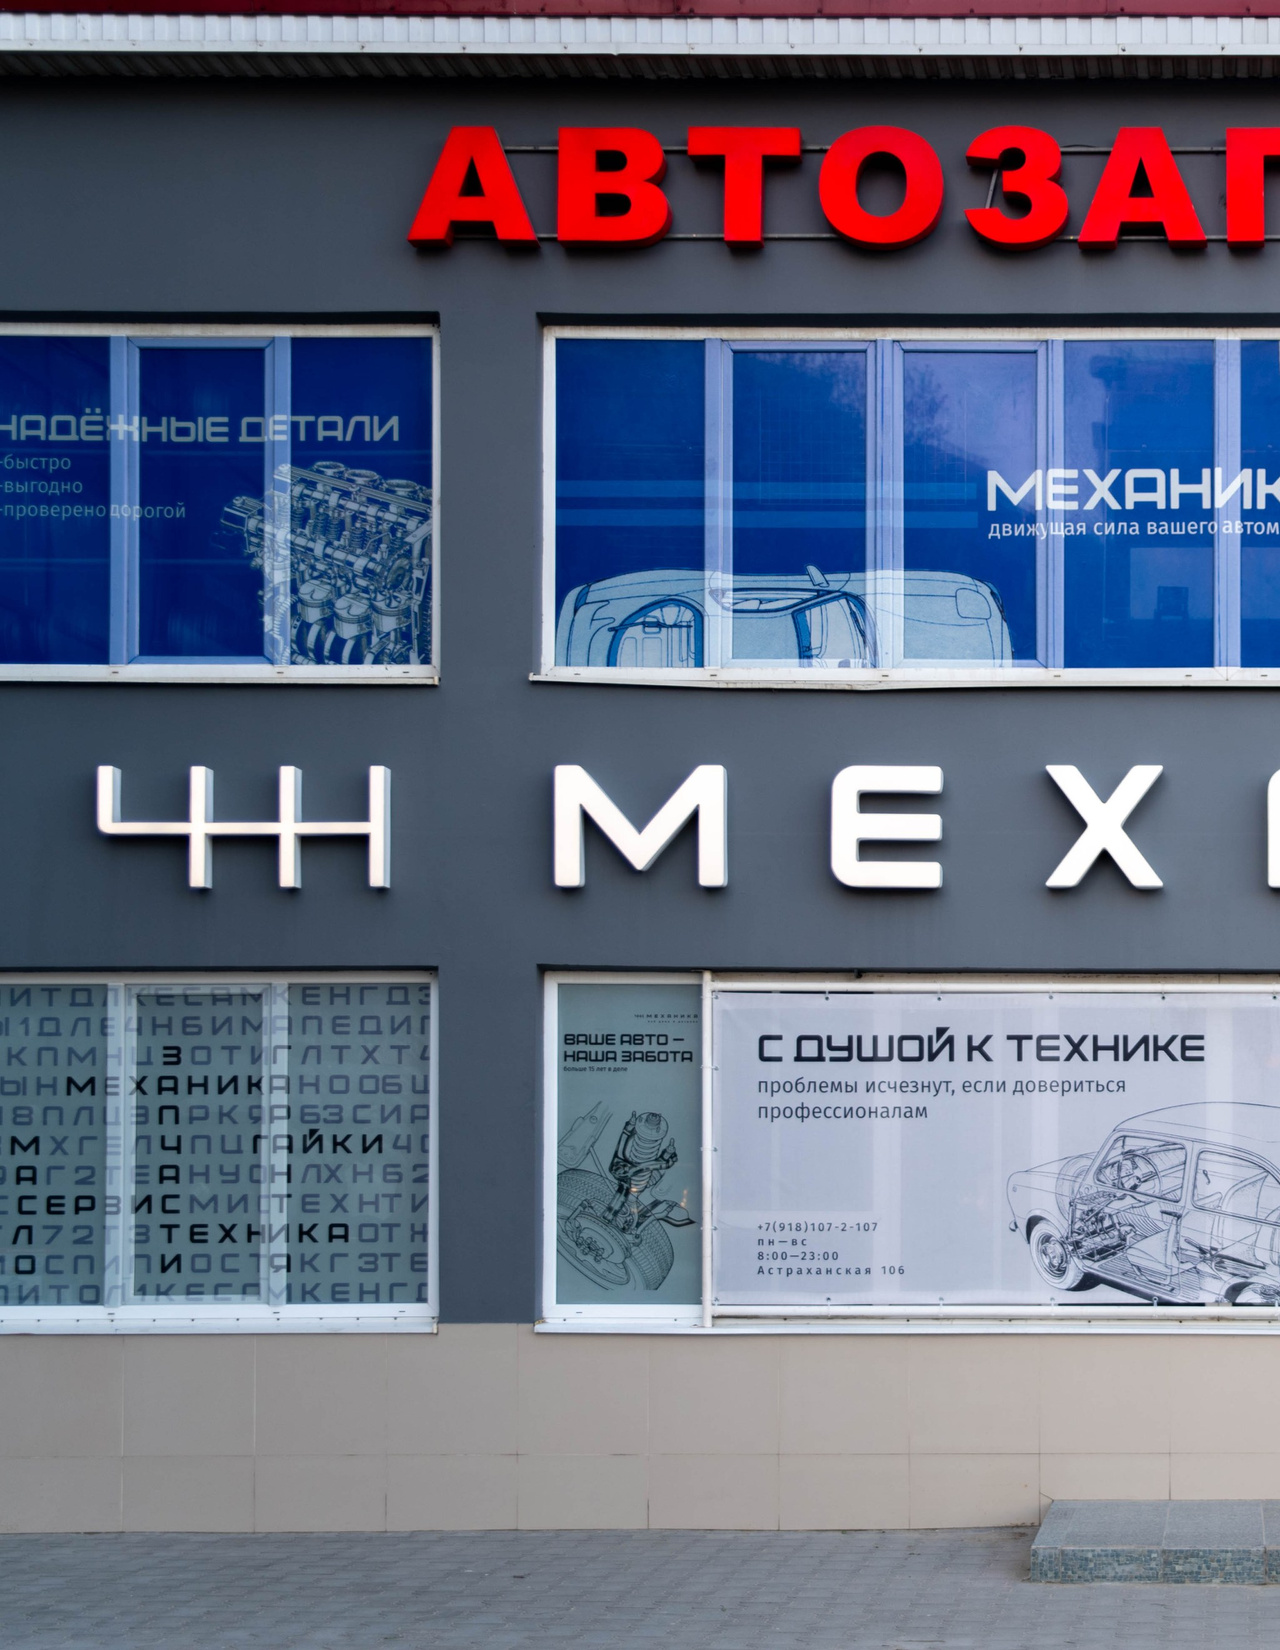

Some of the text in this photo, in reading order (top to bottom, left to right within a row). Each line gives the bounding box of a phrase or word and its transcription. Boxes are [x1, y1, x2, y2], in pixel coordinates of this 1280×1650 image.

[0, 408, 400, 443] НАДЁЖНЫЕ ДЕТАЛИ
[111, 501, 186, 521] дорогой
[988, 520, 1087, 540] движущая
[1093, 521, 1140, 536] сила
[1147, 521, 1218, 536] вашего
[563, 1033, 616, 1046] ВАШЕ
[620, 1033, 669, 1046] АВТО
[758, 1026, 1205, 1062] С ДУШОЙ К ТЕХНИКЕ
[563, 1050, 693, 1063] НАША ЗАБОТА
[757, 1077, 1127, 1097] проблемы исчезнут, если довериться
[757, 1103, 929, 1122] профессионалам
[757, 1221, 878, 1233] +7(918)107-2-107
[757, 1265, 905, 1277] Астраханская 106
